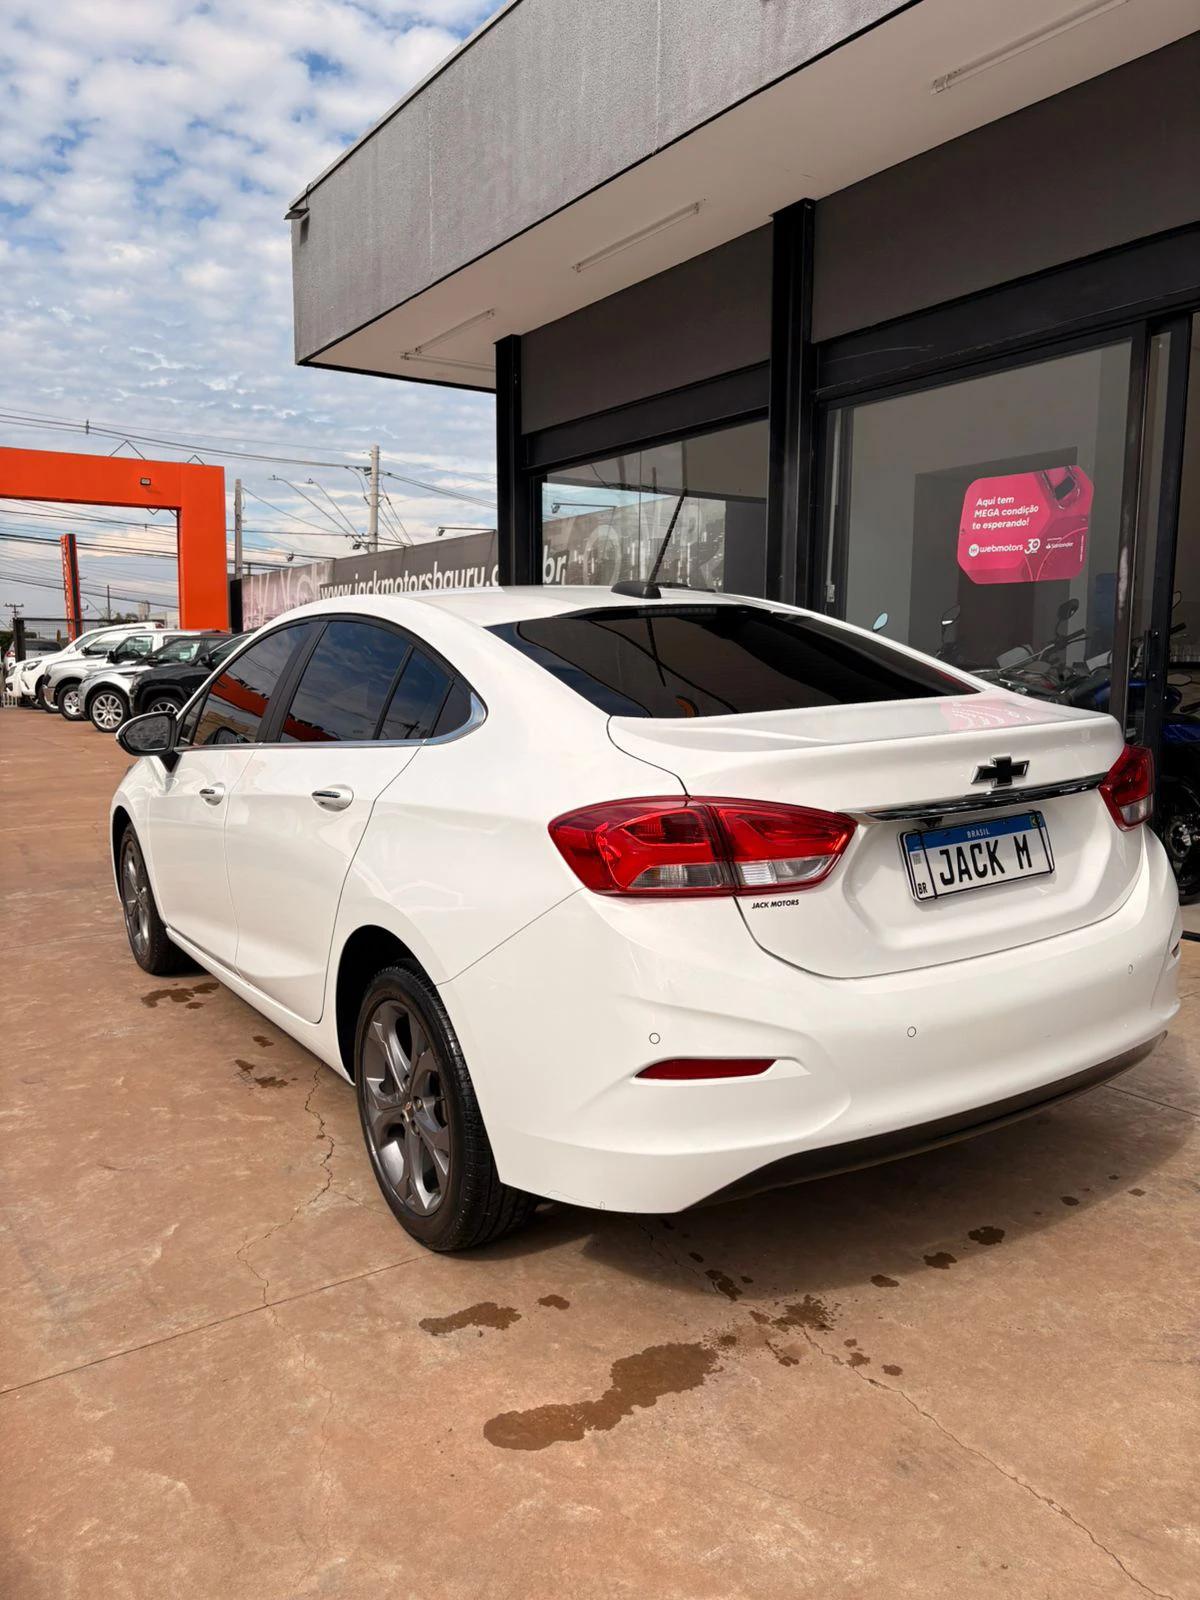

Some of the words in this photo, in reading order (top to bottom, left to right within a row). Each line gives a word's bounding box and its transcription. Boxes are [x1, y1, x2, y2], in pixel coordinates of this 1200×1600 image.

[976, 496, 996, 507] Aqui
[997, 496, 1015, 505] tem
[974, 508, 1000, 518] MEGA
[1001, 505, 1039, 516] condição
[972, 522, 981, 530] te
[982, 517, 1030, 531] esperando!
[979, 543, 1024, 553] webmotors
[1024, 538, 1041, 554] 30
[966, 827, 990, 839] BRASIL
[939, 839, 1006, 886] JACK
[1013, 834, 1033, 870] M
[917, 882, 928, 895] BR
[770, 899, 800, 908] MOTORS
